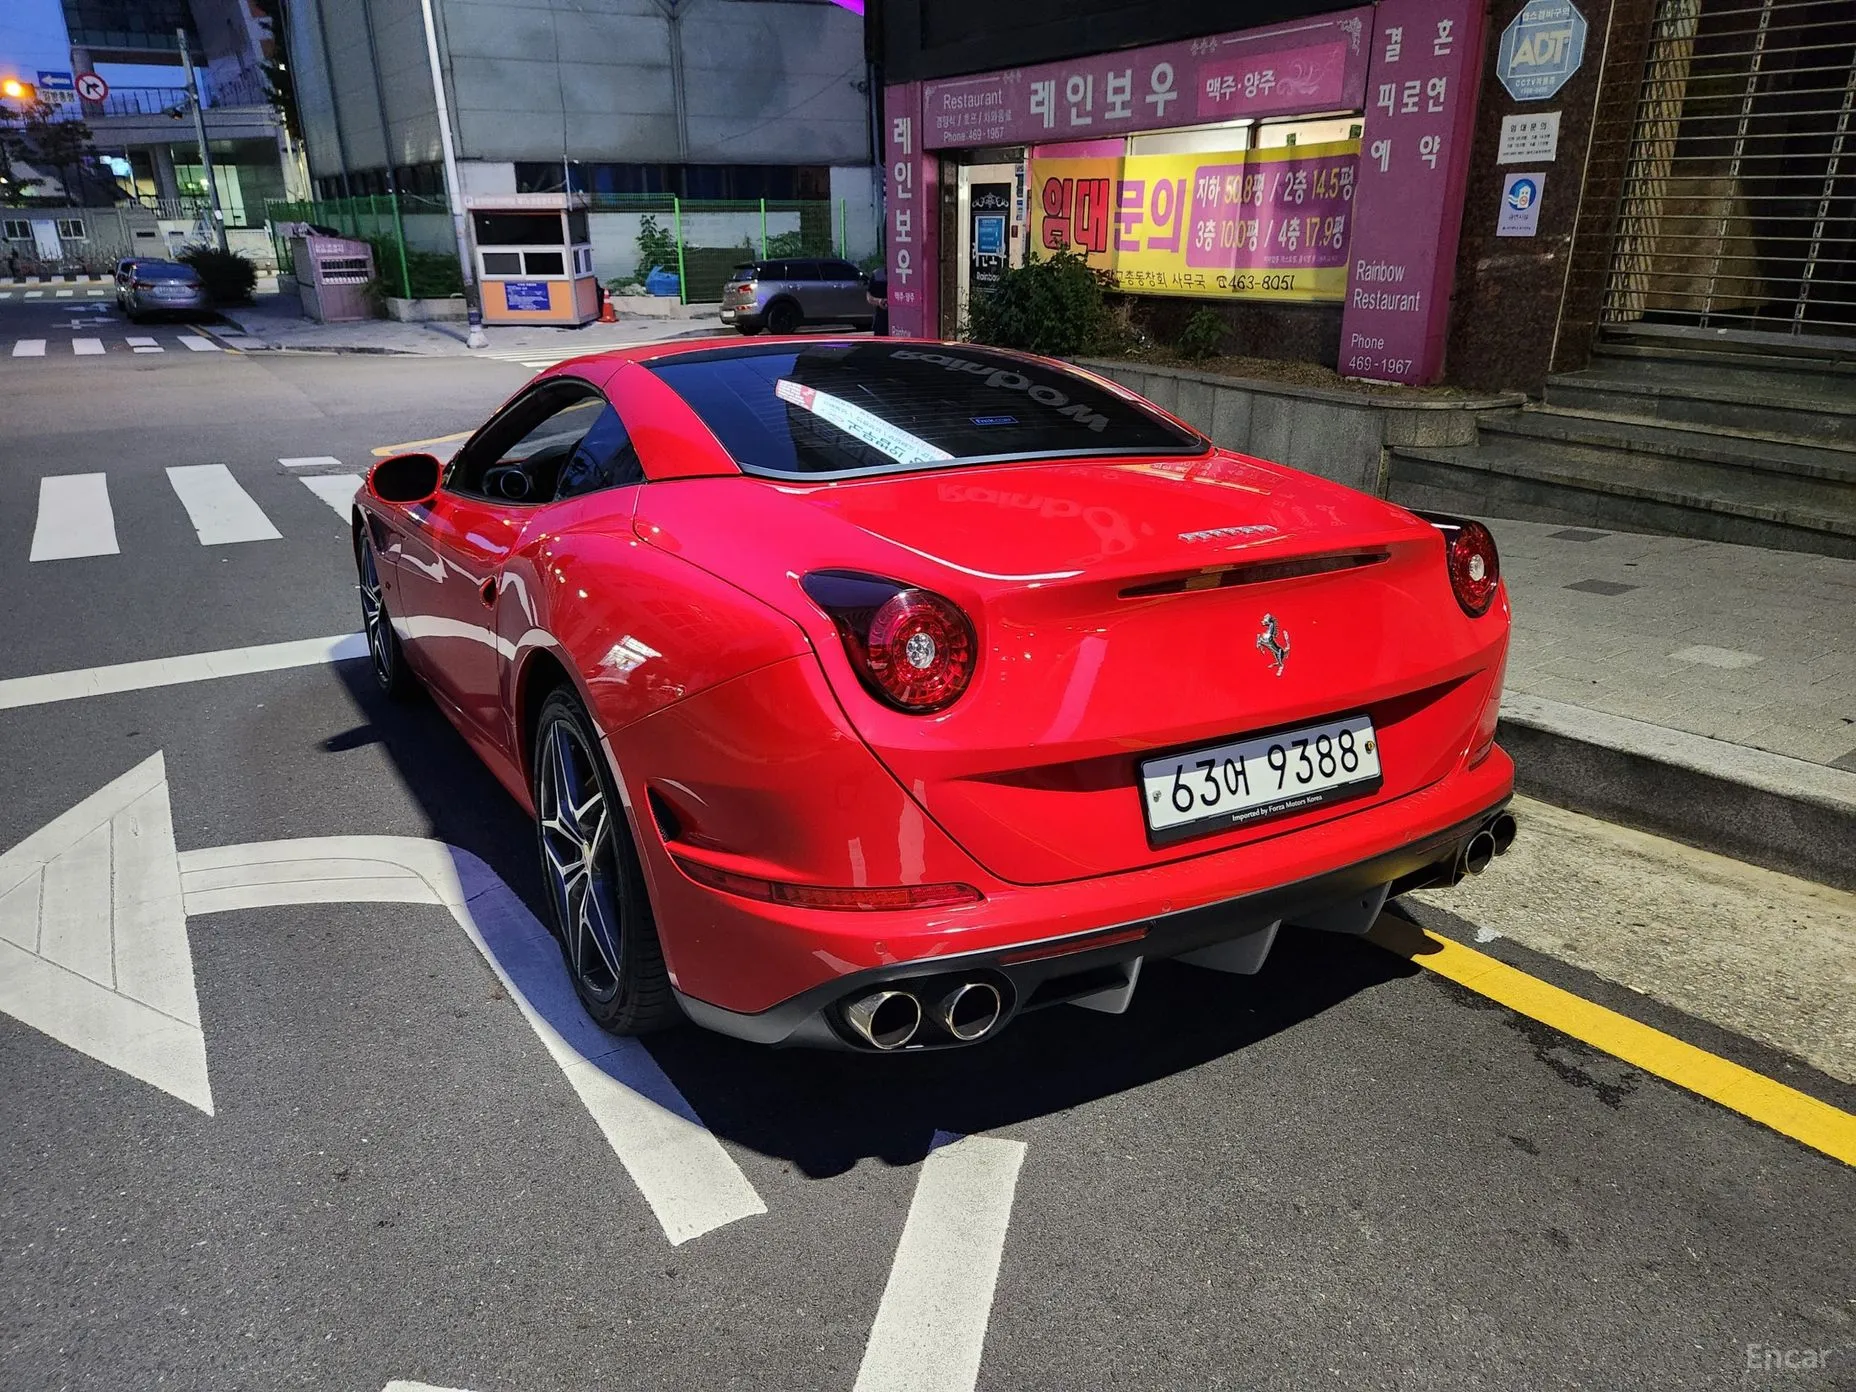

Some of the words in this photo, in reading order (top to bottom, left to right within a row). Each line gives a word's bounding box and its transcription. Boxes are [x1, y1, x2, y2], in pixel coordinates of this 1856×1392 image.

[1385, 18, 1453, 63] 결혼
[1510, 29, 1571, 68] ADT
[943, 88, 1003, 110] Restaurant
[1030, 62, 1178, 128] 레인보우
[1377, 77, 1447, 117] 피로연
[1371, 135, 1441, 173] 예약
[893, 117, 912, 284] 레인보우
[1197, 175, 1220, 208] 지하
[1224, 172, 1265, 207] 50.8평
[1284, 169, 1308, 205] 2층
[1312, 165, 1354, 201] 14.5평
[1195, 219, 1217, 251] 3층
[1220, 218, 1259, 251] 10.0평
[1278, 216, 1300, 251] 4층
[1305, 215, 1346, 250] 17.9평
[1172, 273, 1206, 289] 사무국
[1228, 274, 1296, 291] 463-8051
[1356, 259, 1406, 283] Rainbow
[1353, 288, 1421, 312] Restaurant
[1351, 333, 1384, 350] Phone
[1172, 755, 1250, 813] 63어
[1267, 729, 1359, 790] 9388
[1232, 808, 1260, 821] Imported
[1260, 806, 1268, 817] by
[1269, 802, 1285, 813] Forza
[1285, 798, 1306, 810] Motors
[1306, 794, 1323, 807] Korea
